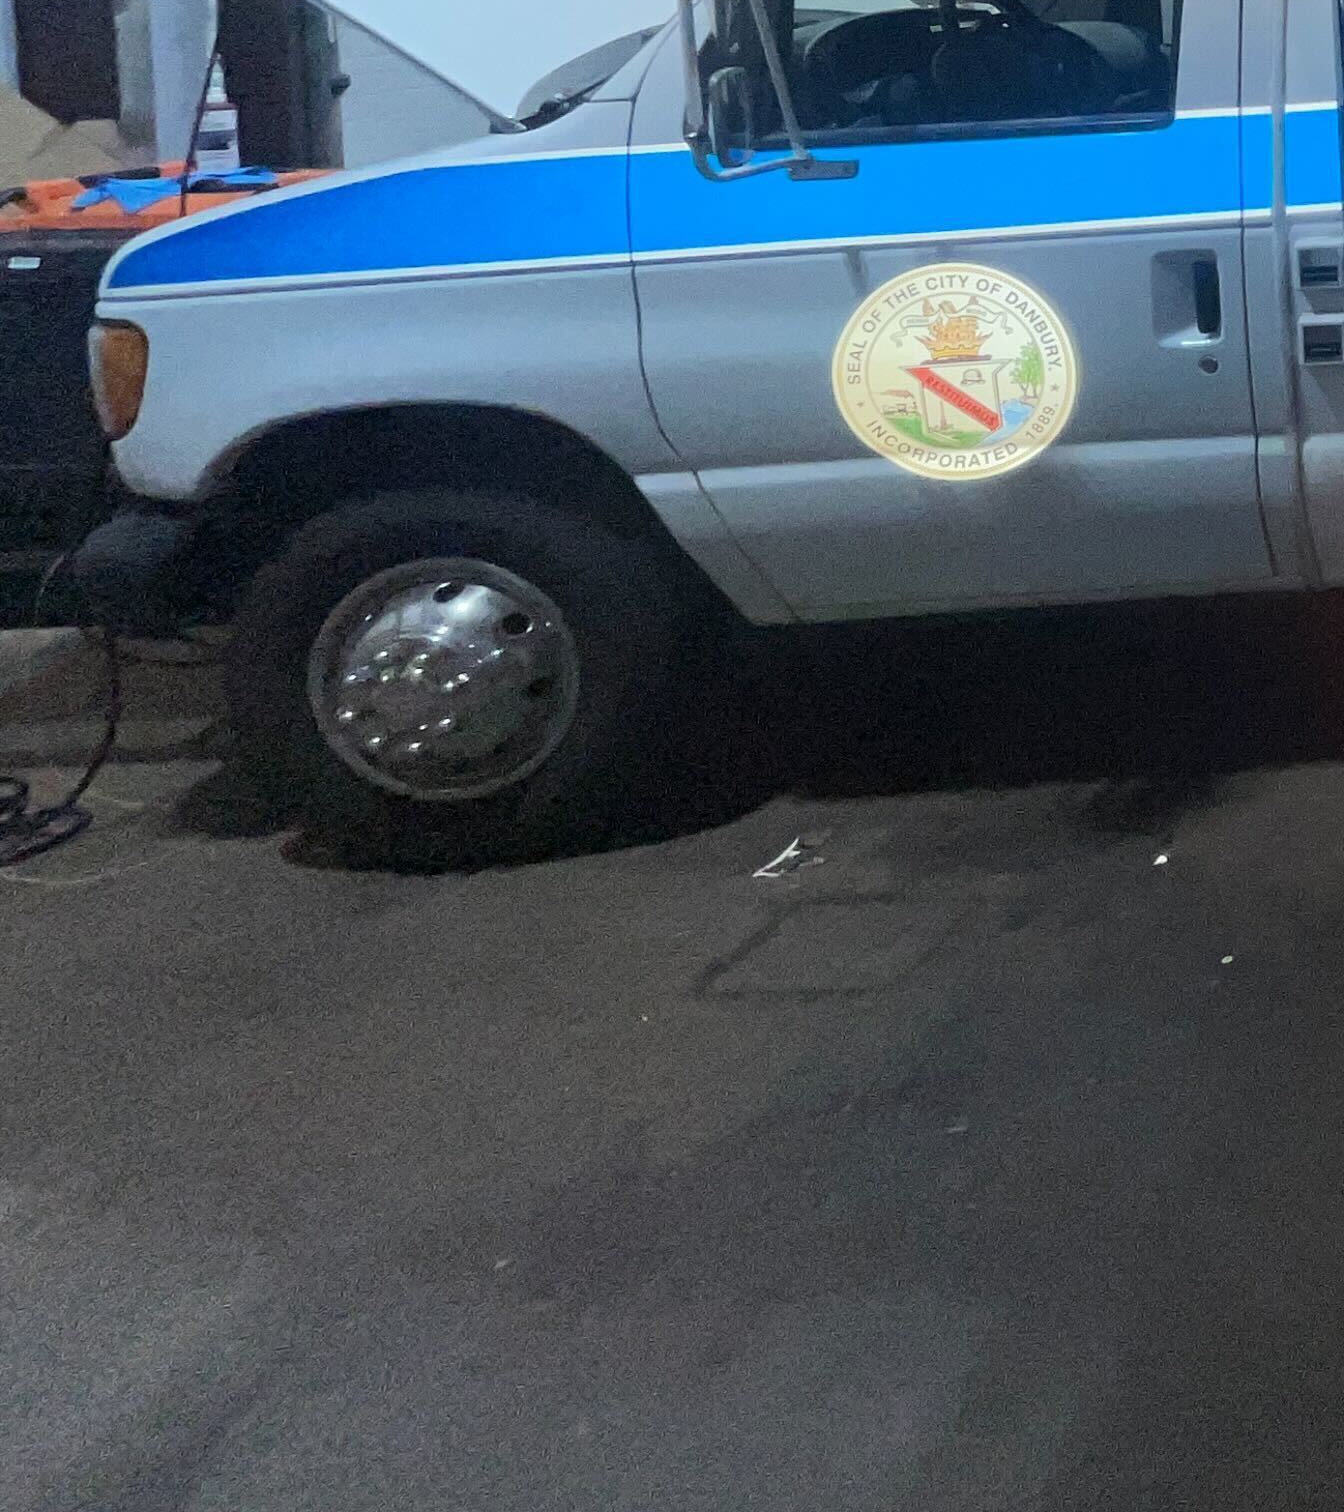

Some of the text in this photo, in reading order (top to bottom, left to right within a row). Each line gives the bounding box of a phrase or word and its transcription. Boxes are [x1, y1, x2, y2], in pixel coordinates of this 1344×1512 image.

[847, 340, 868, 385] SEAL
[862, 311, 883, 334] OF
[885, 283, 920, 310] THE
[925, 274, 969, 291] CITY
[975, 277, 1003, 294] OF
[866, 419, 1018, 468] INCORPORATED
